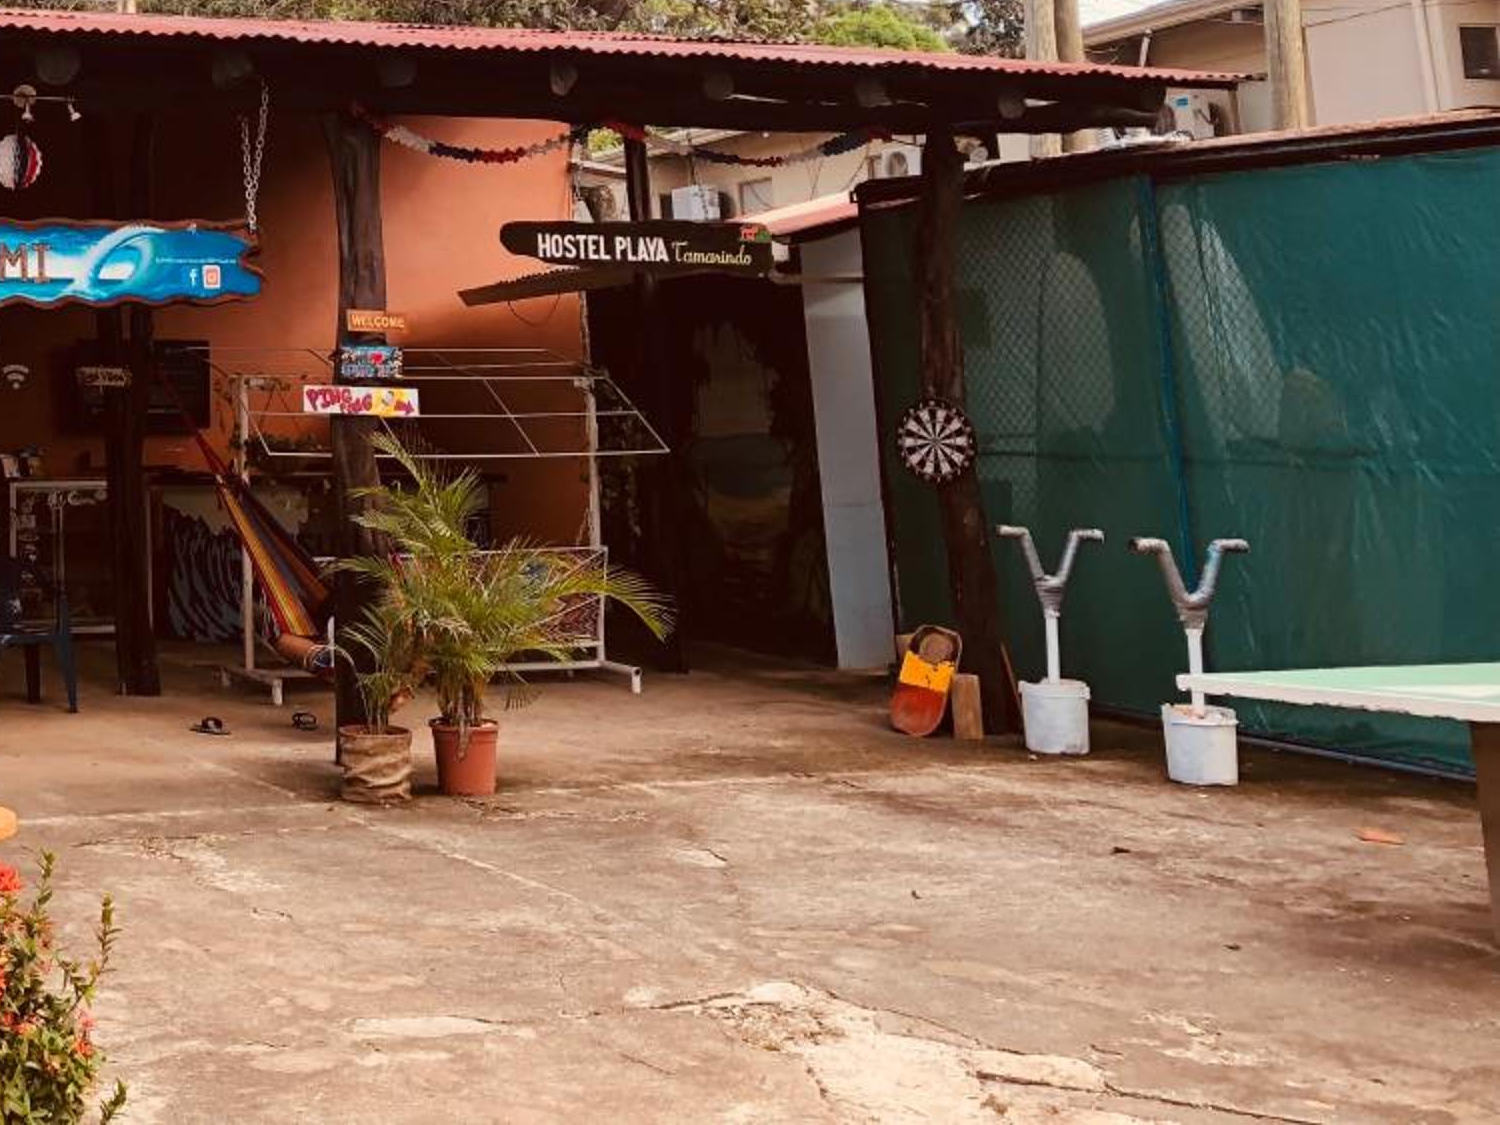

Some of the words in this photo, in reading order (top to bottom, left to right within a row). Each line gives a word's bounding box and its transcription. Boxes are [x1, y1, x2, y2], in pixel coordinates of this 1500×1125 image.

[537, 233, 611, 261] HOSTEL
[614, 236, 670, 263] PLAYA
[672, 241, 753, 266] Tamarindo
[351, 313, 405, 329] WELCOME
[306, 388, 352, 411] PING
